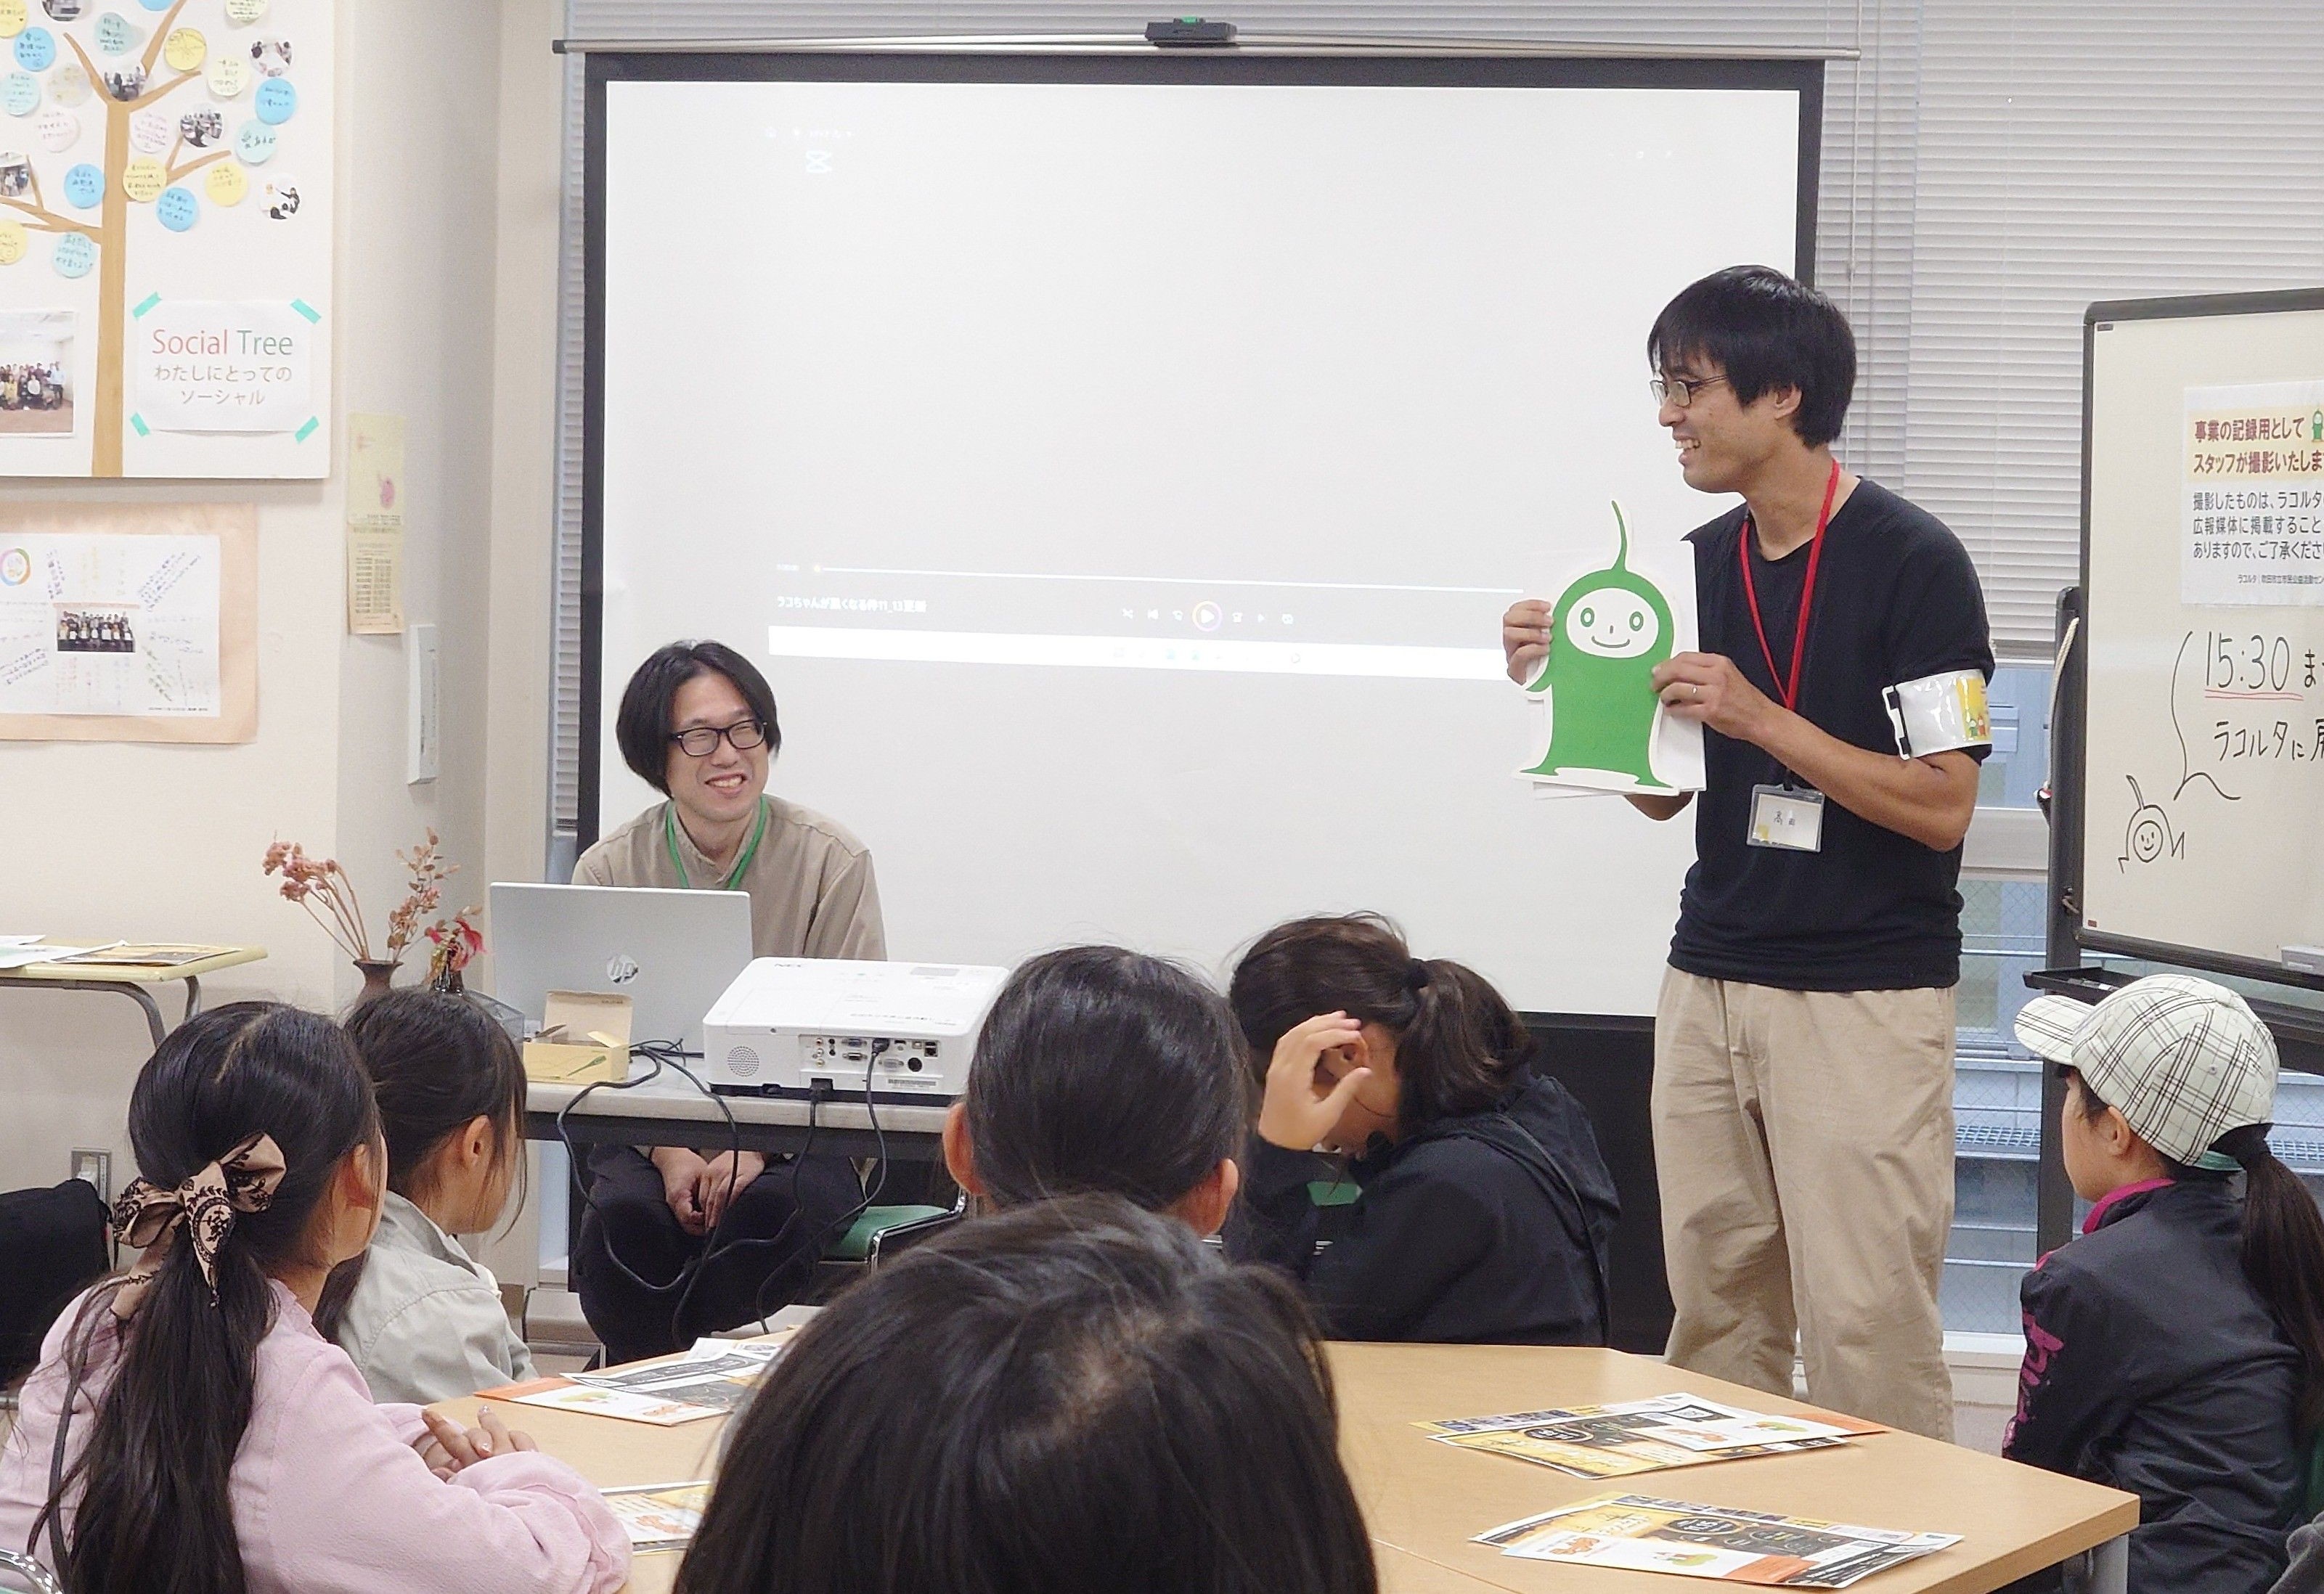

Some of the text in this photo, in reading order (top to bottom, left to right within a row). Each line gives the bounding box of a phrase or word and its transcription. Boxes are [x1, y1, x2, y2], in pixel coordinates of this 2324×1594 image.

[152, 329, 293, 355] Social Tree
[154, 364, 293, 383] わたしにとっての
[180, 389, 265, 406] ソーシャル
[2194, 417, 2305, 443] 事業の記録用として
[2193, 450, 2324, 474] スタッフが撮影いたしま
[2193, 491, 2324, 510] 撮影したものは、ラコルタ
[2193, 541, 2324, 560] ありますので、ご了承くださ
[2204, 632, 2324, 691] 15:30 ま
